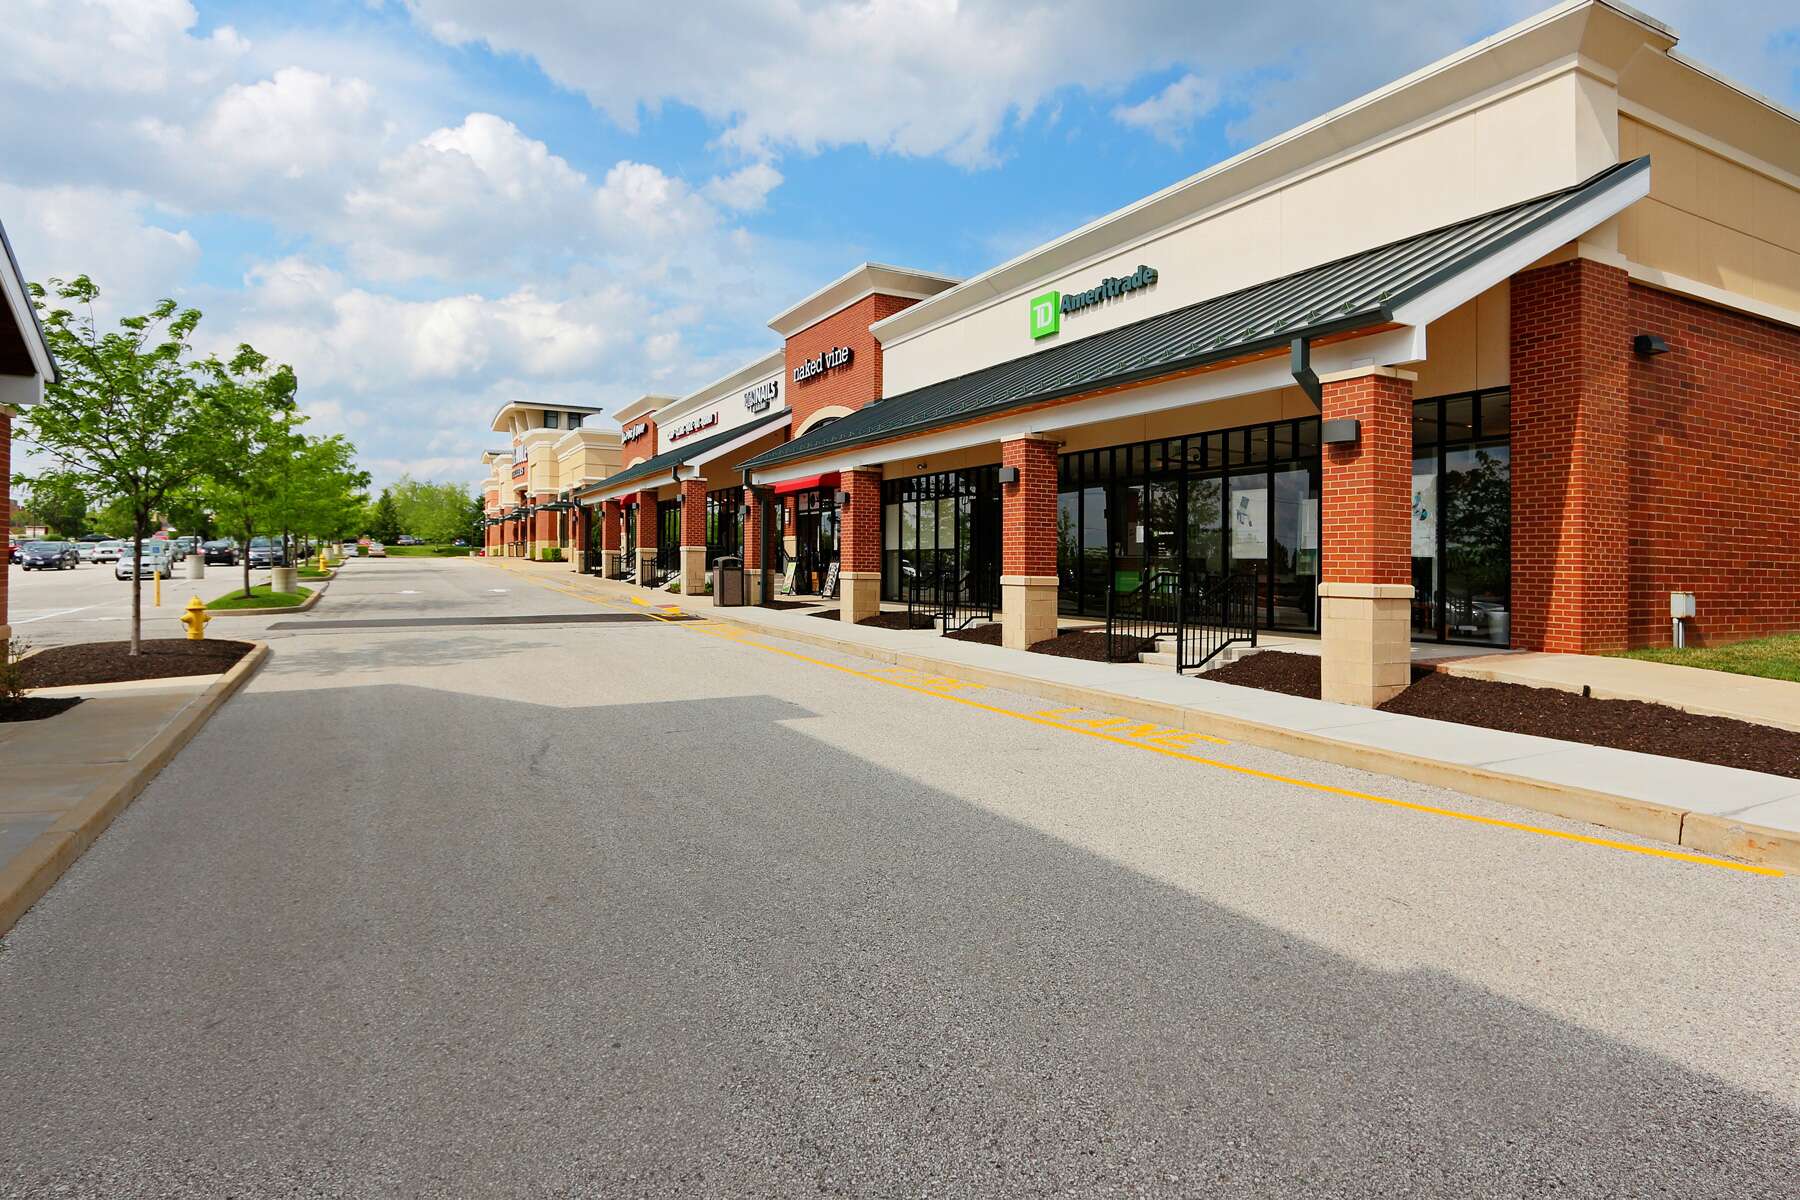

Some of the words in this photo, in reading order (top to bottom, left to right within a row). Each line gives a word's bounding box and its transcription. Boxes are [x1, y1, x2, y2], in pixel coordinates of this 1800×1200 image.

[1032, 302, 1054, 329] TD
[1060, 265, 1157, 314] Ameritrade
[793, 352, 824, 382] naked
[825, 346, 851, 368] vine
[1033, 706, 1232, 749] LANE
